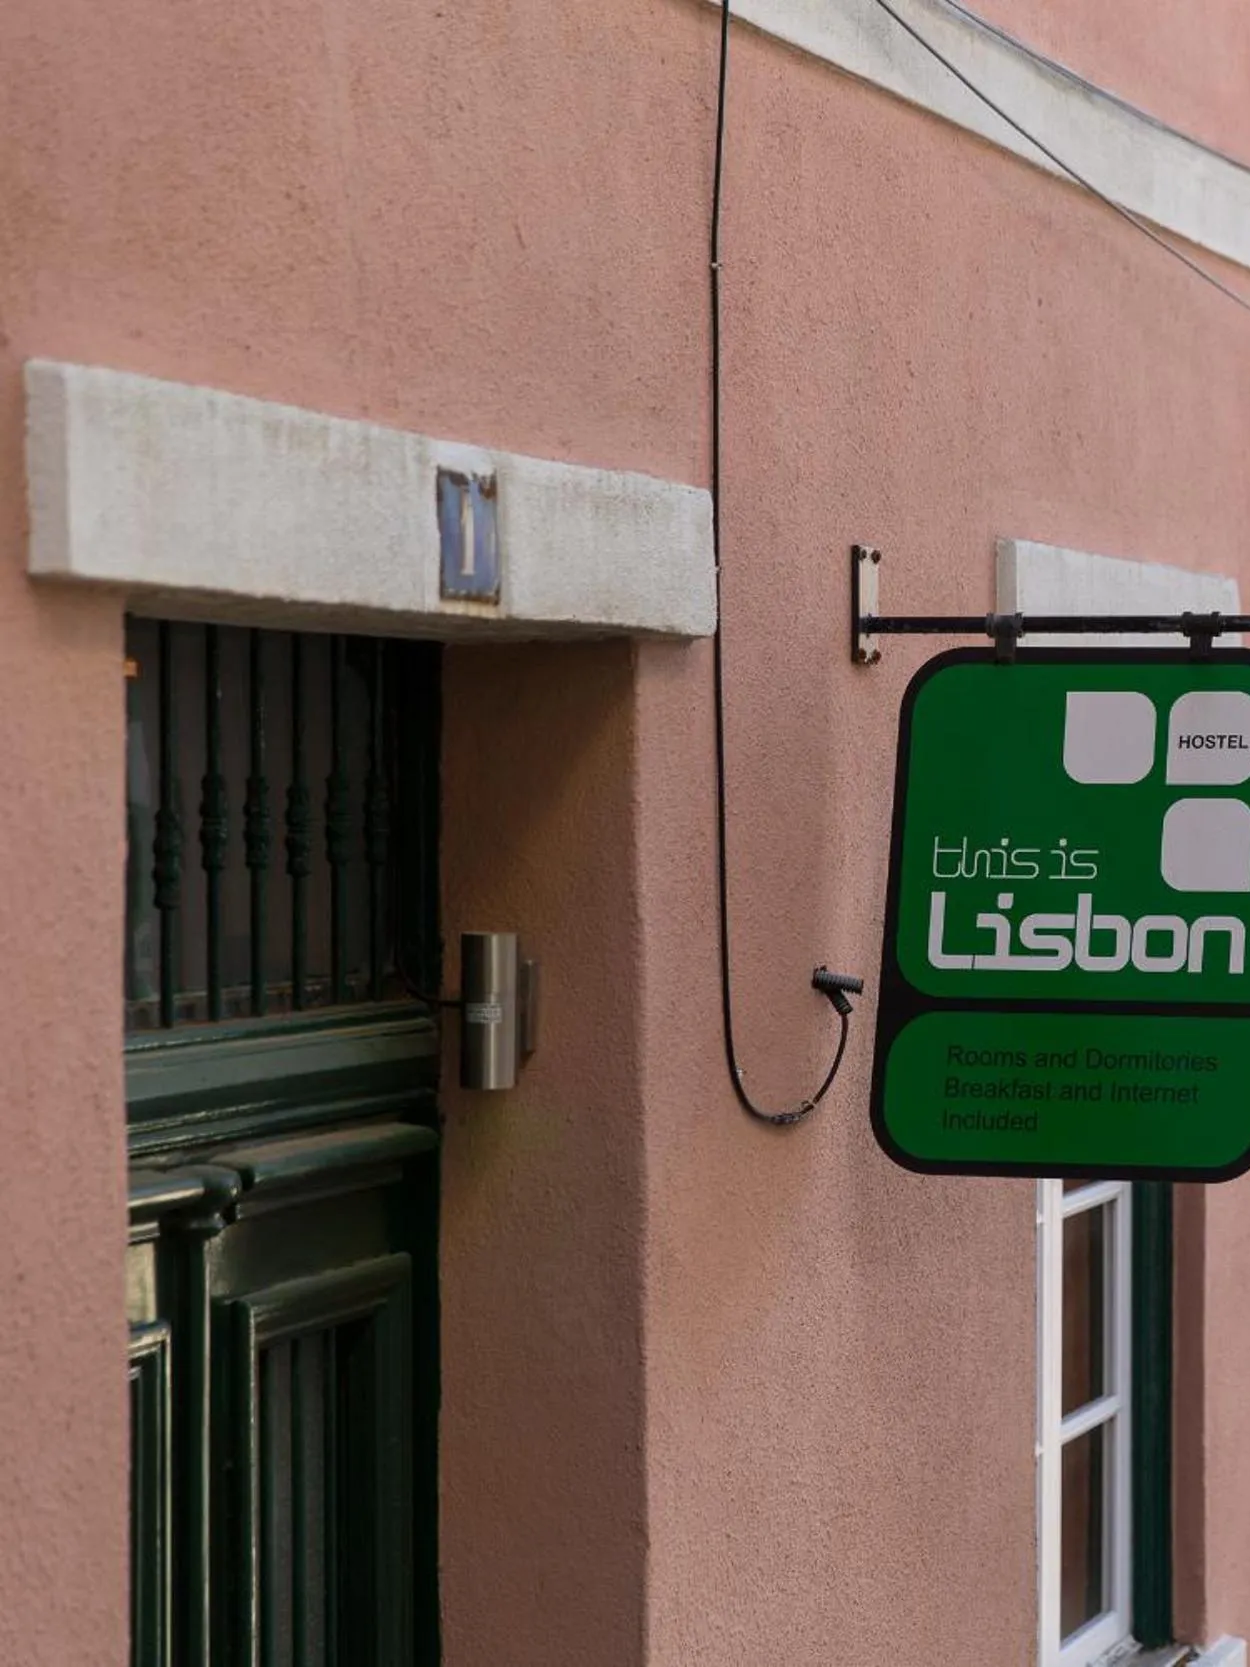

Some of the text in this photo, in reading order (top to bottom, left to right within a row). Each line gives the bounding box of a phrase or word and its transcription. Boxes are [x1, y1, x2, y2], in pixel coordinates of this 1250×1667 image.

[460, 484, 476, 576] 1
[1178, 734, 1249, 750] HOSTEL
[933, 836, 1100, 880] this is
[928, 891, 1246, 974] Lisbon
[946, 1045, 1220, 1073] Rooms and Dormitories
[944, 1076, 1200, 1105] Breakfast and Internet
[941, 1108, 1039, 1132] Included
